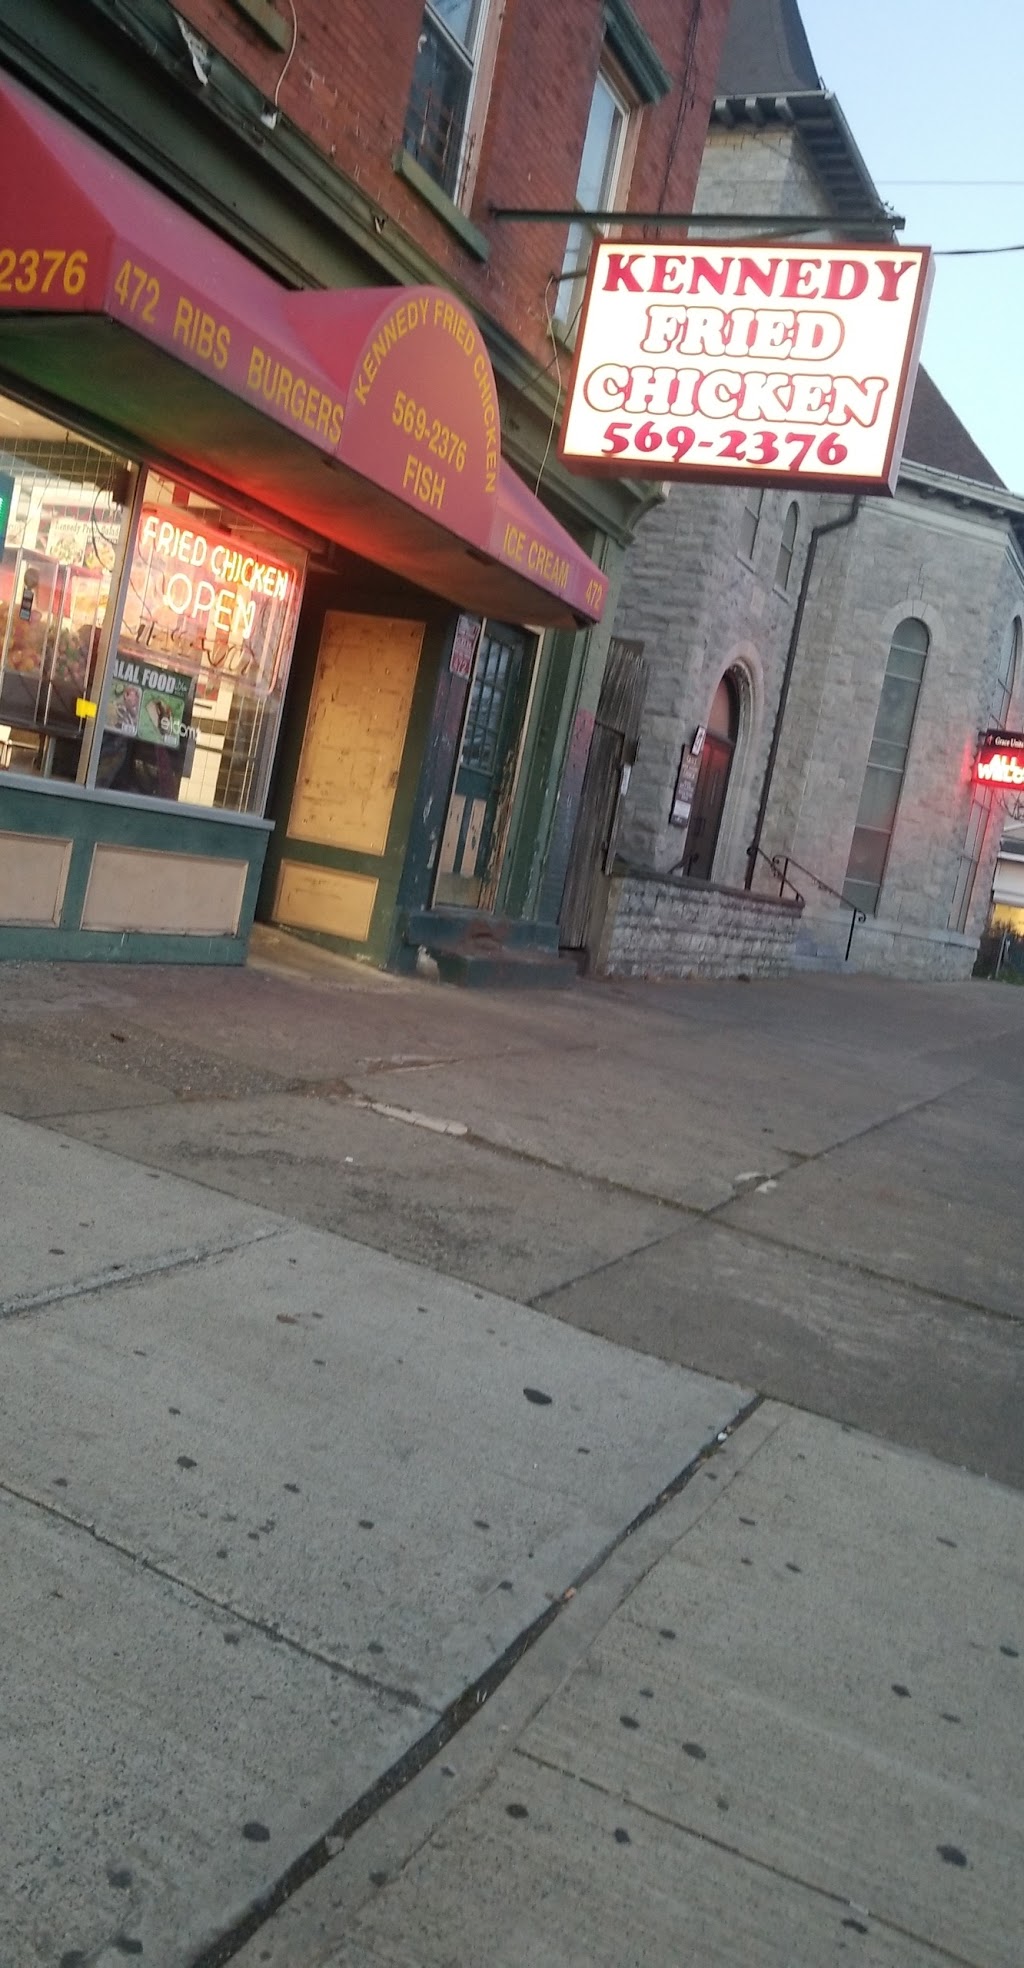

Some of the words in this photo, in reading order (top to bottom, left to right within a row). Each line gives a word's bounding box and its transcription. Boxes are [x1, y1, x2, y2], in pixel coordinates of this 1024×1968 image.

[0, 248, 88, 295] 2376
[602, 254, 917, 301] KENNEDY
[113, 259, 160, 324] 472
[172, 296, 230, 370] RIBS
[246, 345, 344, 445] BURGERS
[639, 304, 845, 361] FRIED
[354, 297, 430, 405] KENNEDY
[434, 298, 475, 356] FRIED
[474, 354, 497, 492] CHICKEN
[583, 363, 889, 428] CHICKEN
[392, 389, 467, 472] 569-2376
[601, 421, 848, 471] 569-2376
[403, 454, 446, 510] FISH
[142, 515, 207, 567] FRIED
[210, 545, 288, 601] CHICKEN
[503, 522, 526, 563] ICE
[527, 540, 569, 589] CREAM
[163, 573, 256, 639] OPEN
[585, 579, 602, 610] 472
[142, 668, 176, 694] FOOD
